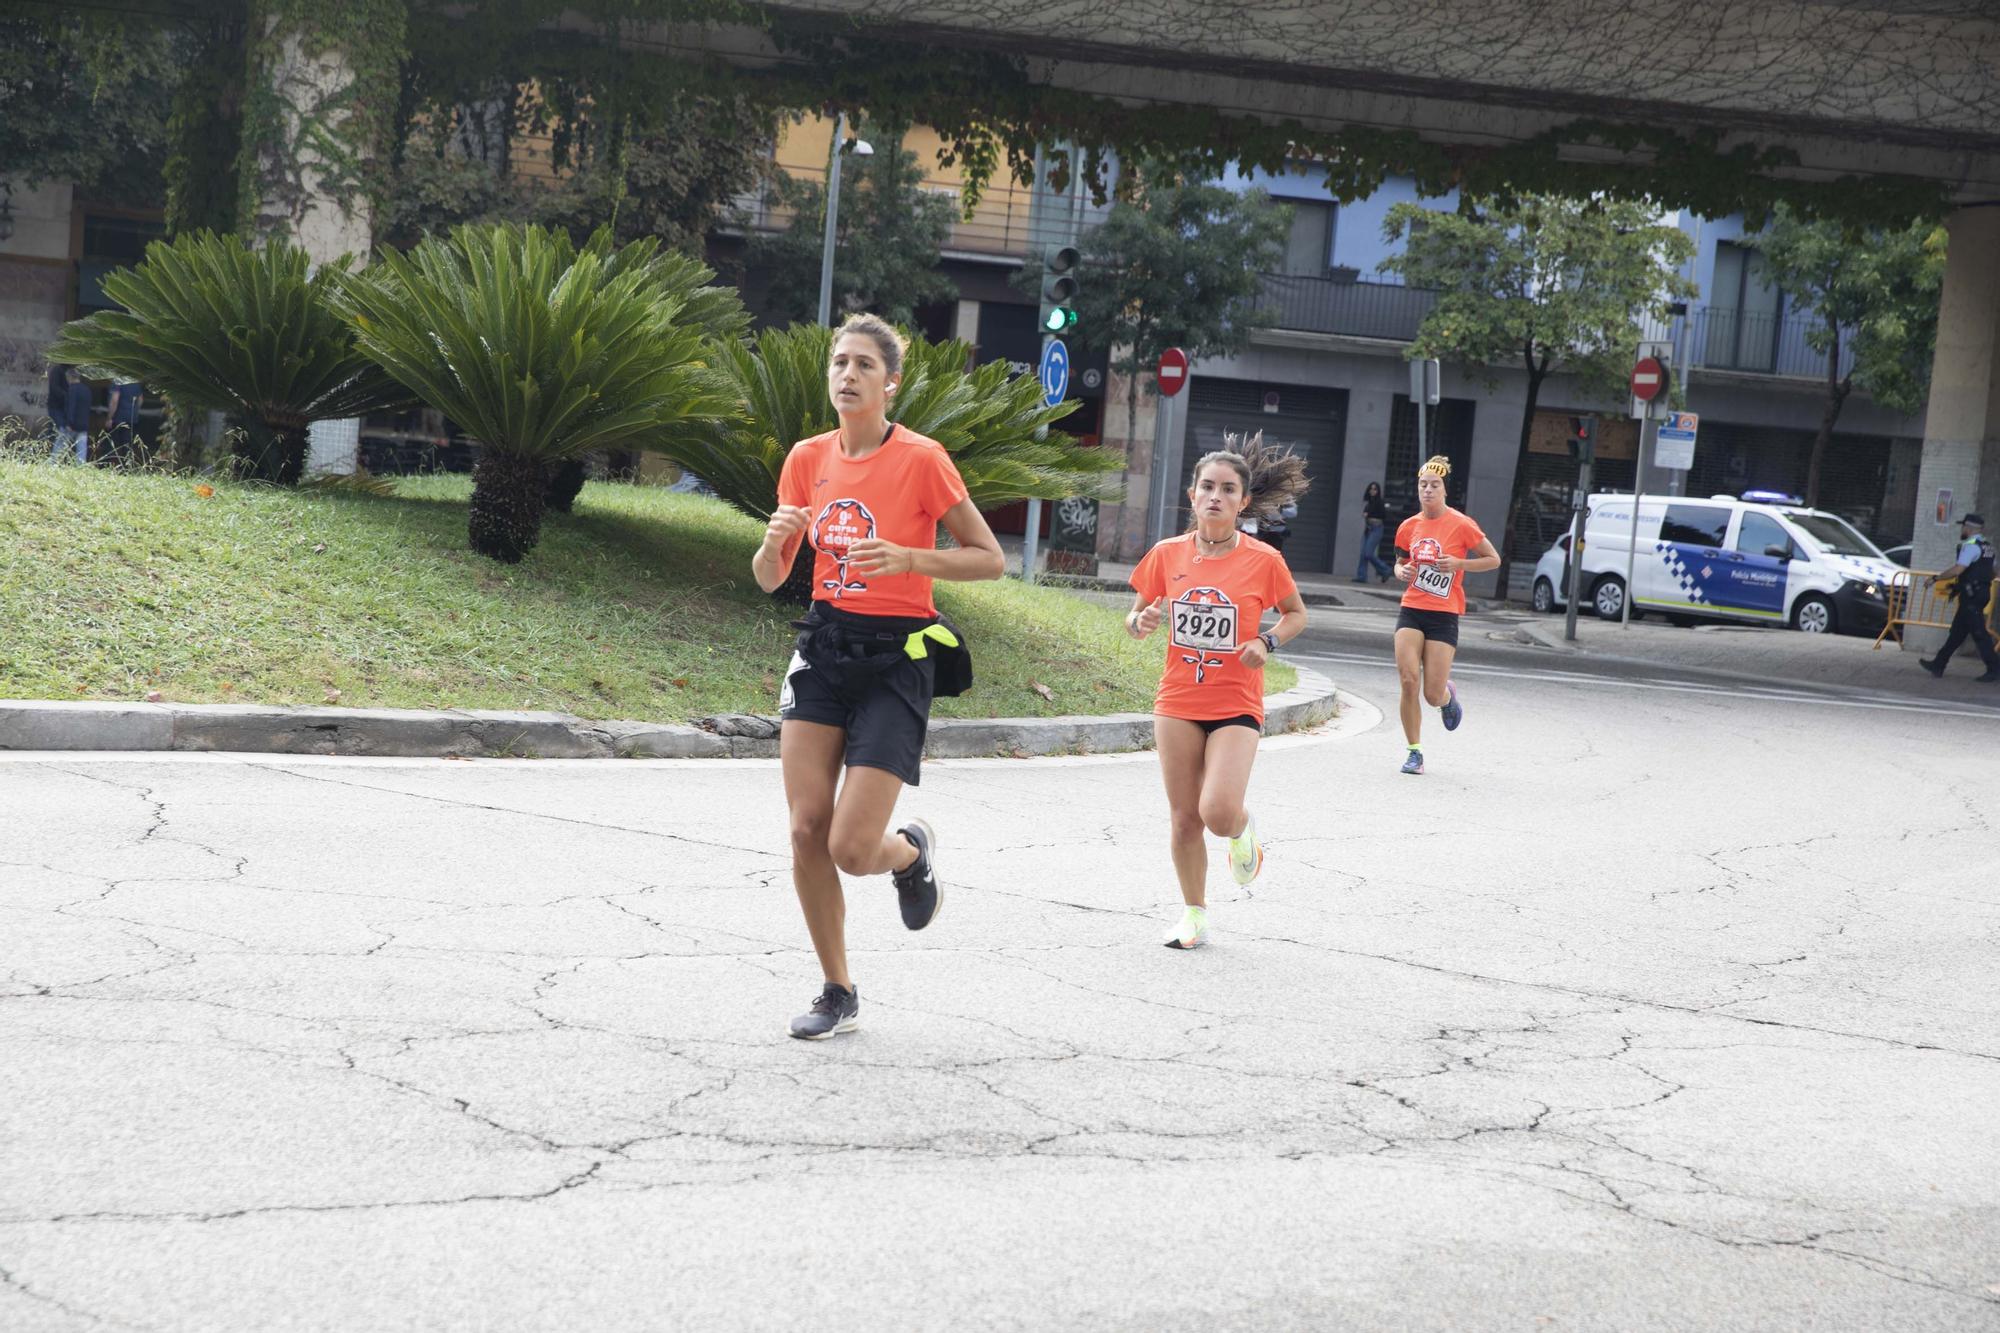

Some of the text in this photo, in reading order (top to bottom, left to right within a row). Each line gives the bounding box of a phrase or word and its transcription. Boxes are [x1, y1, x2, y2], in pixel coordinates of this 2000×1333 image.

[828, 524, 858, 534] cursa
[1419, 570, 1449, 589] 4400
[1177, 613, 1231, 639] 2920
